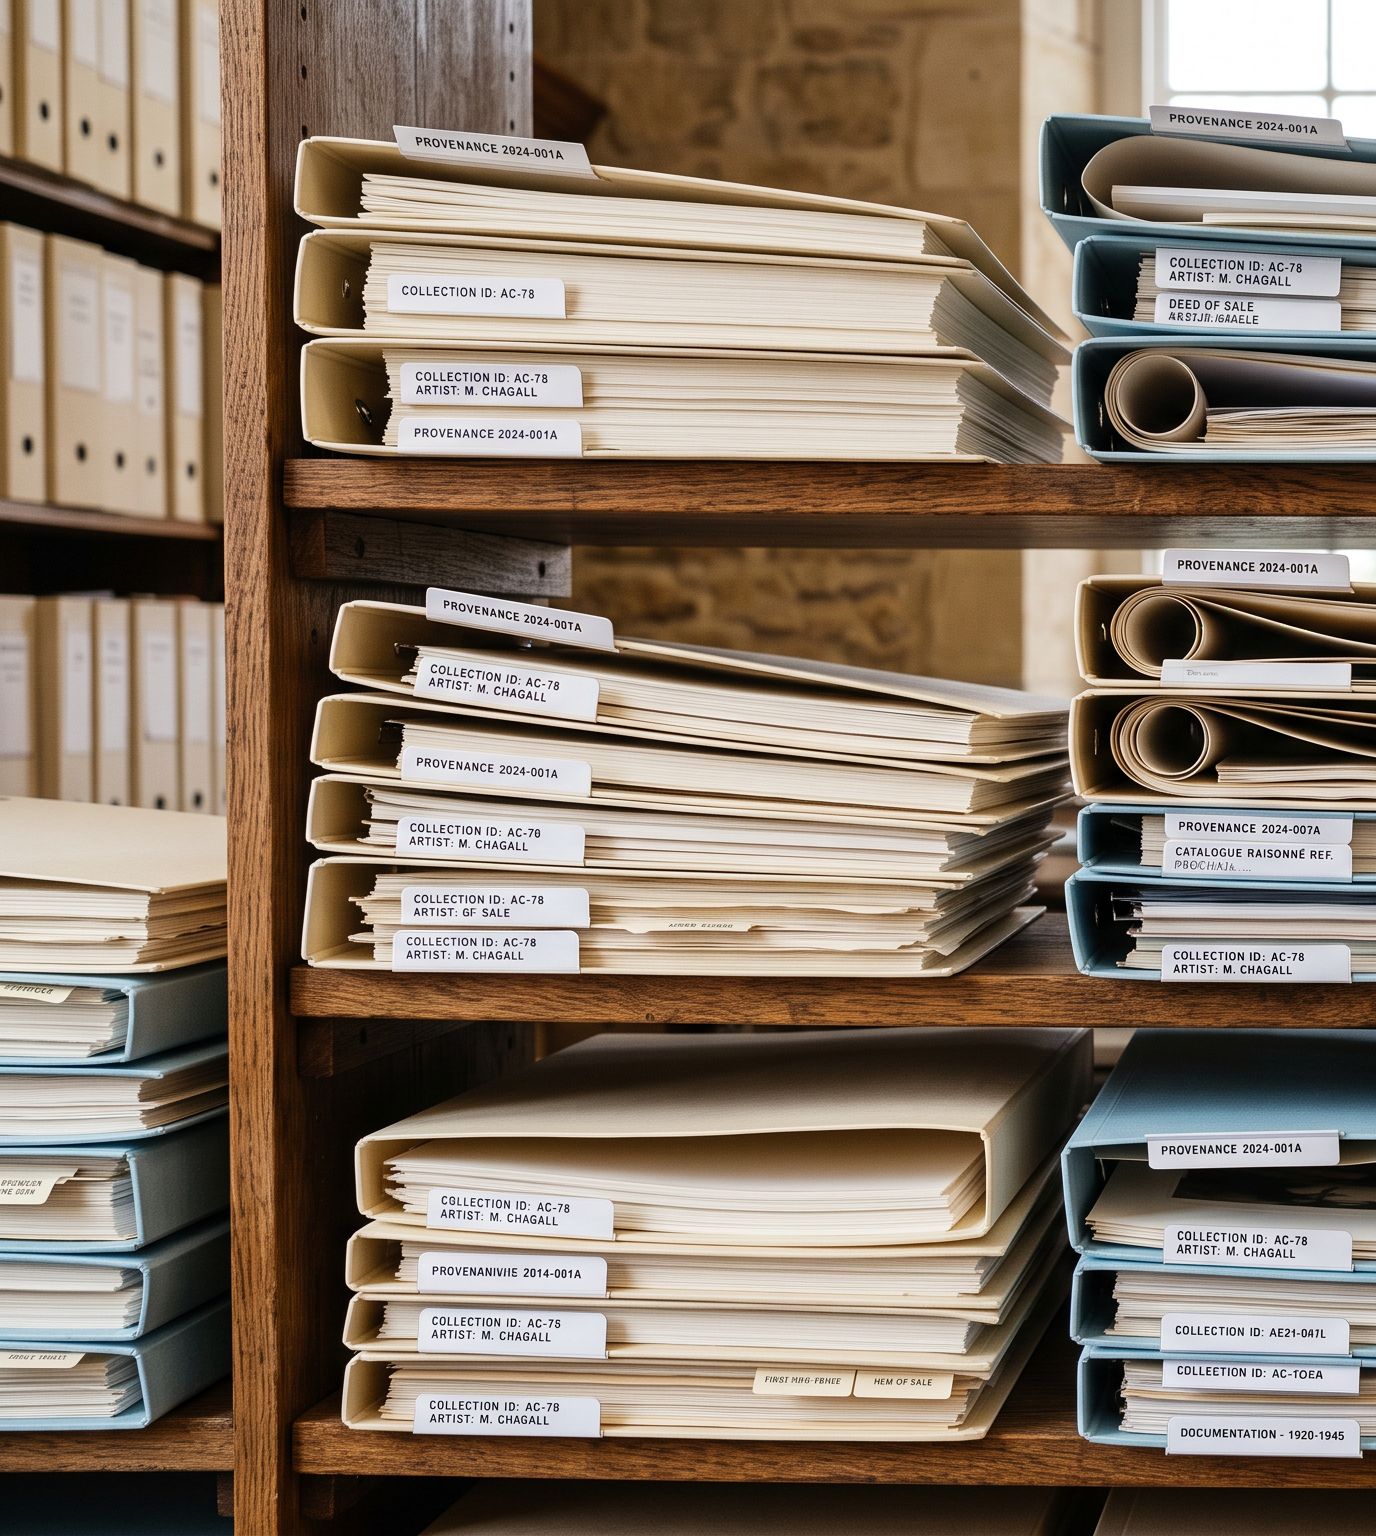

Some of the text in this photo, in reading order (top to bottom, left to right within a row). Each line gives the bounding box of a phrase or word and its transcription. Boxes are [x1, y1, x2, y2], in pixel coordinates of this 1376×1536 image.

[1169, 113, 1318, 135] PROVENANCE 2024-001A
[415, 136, 564, 160] PROVENANCE 2024-001A
[1169, 257, 1303, 274] COLLECTION ID: AC-78
[1169, 270, 1292, 287] ARTIST: M. CHAGALL
[401, 285, 535, 300] COLLECTION ID: AC-78
[1169, 298, 1254, 312] DEED OF SALE
[415, 371, 548, 384] COLLECTION ID: AC-78
[415, 385, 538, 398] ARTIST: M. CHAGALL
[414, 427, 558, 440] PROVENANCE 2024-001A
[1177, 559, 1319, 574] PROVENANCE 2024-001A
[443, 599, 520, 622] PROVENANCE
[430, 663, 560, 691] COLLECTION ID: AC-78
[428, 677, 546, 703] ARTIST: M. CHAGALL
[416, 757, 558, 779] PROVENANCE 2024-001A
[409, 822, 482, 836] COLLECTION
[1178, 821, 1256, 834] PROVENANCE
[409, 836, 529, 852] ARTIST: M. CHAGALL
[1175, 846, 1333, 860] CATALOGUE RAISONNÉ REF.
[413, 894, 544, 905] COLLECTION ID: AC-78
[413, 907, 458, 917] ARTIST:
[482, 907, 510, 918] SALE
[406, 936, 537, 948] COLLECTION ID: AC-78
[406, 949, 524, 961] ARTIST: M. CHAGALL
[1173, 950, 1305, 962] COLLECTION ID: AC-78
[1173, 964, 1293, 975] ARTIST: M. CHAGALL
[1161, 1143, 1302, 1155] PROVENANCE 2024-001A
[515, 1200, 531, 1211] ID:
[536, 1202, 570, 1214] AC-78
[440, 1208, 559, 1226] ARTIST: M. CHAGALL
[1177, 1230, 1308, 1246] COLLECTION ID: AC-78
[1176, 1243, 1296, 1259] ARTIST: M. CHAGALL
[523, 1267, 582, 1279] 2014-001A
[431, 1316, 501, 1328] COLLECTION
[506, 1318, 521, 1328] ID:
[431, 1329, 551, 1343] ARTIST: M. CHAGALL
[1175, 1325, 1245, 1337] COLLECTION
[1250, 1327, 1264, 1337] ID:
[1251, 1368, 1266, 1378] ID:
[873, 1378, 933, 1387] HEM OF SALE
[429, 1400, 560, 1413] COLLECTION ID: AC-78
[429, 1413, 549, 1426] ARTIST: M. CHAGALL
[1180, 1427, 1277, 1439] DOCUMENTATION
[1288, 1430, 1345, 1441] 1920-1945
